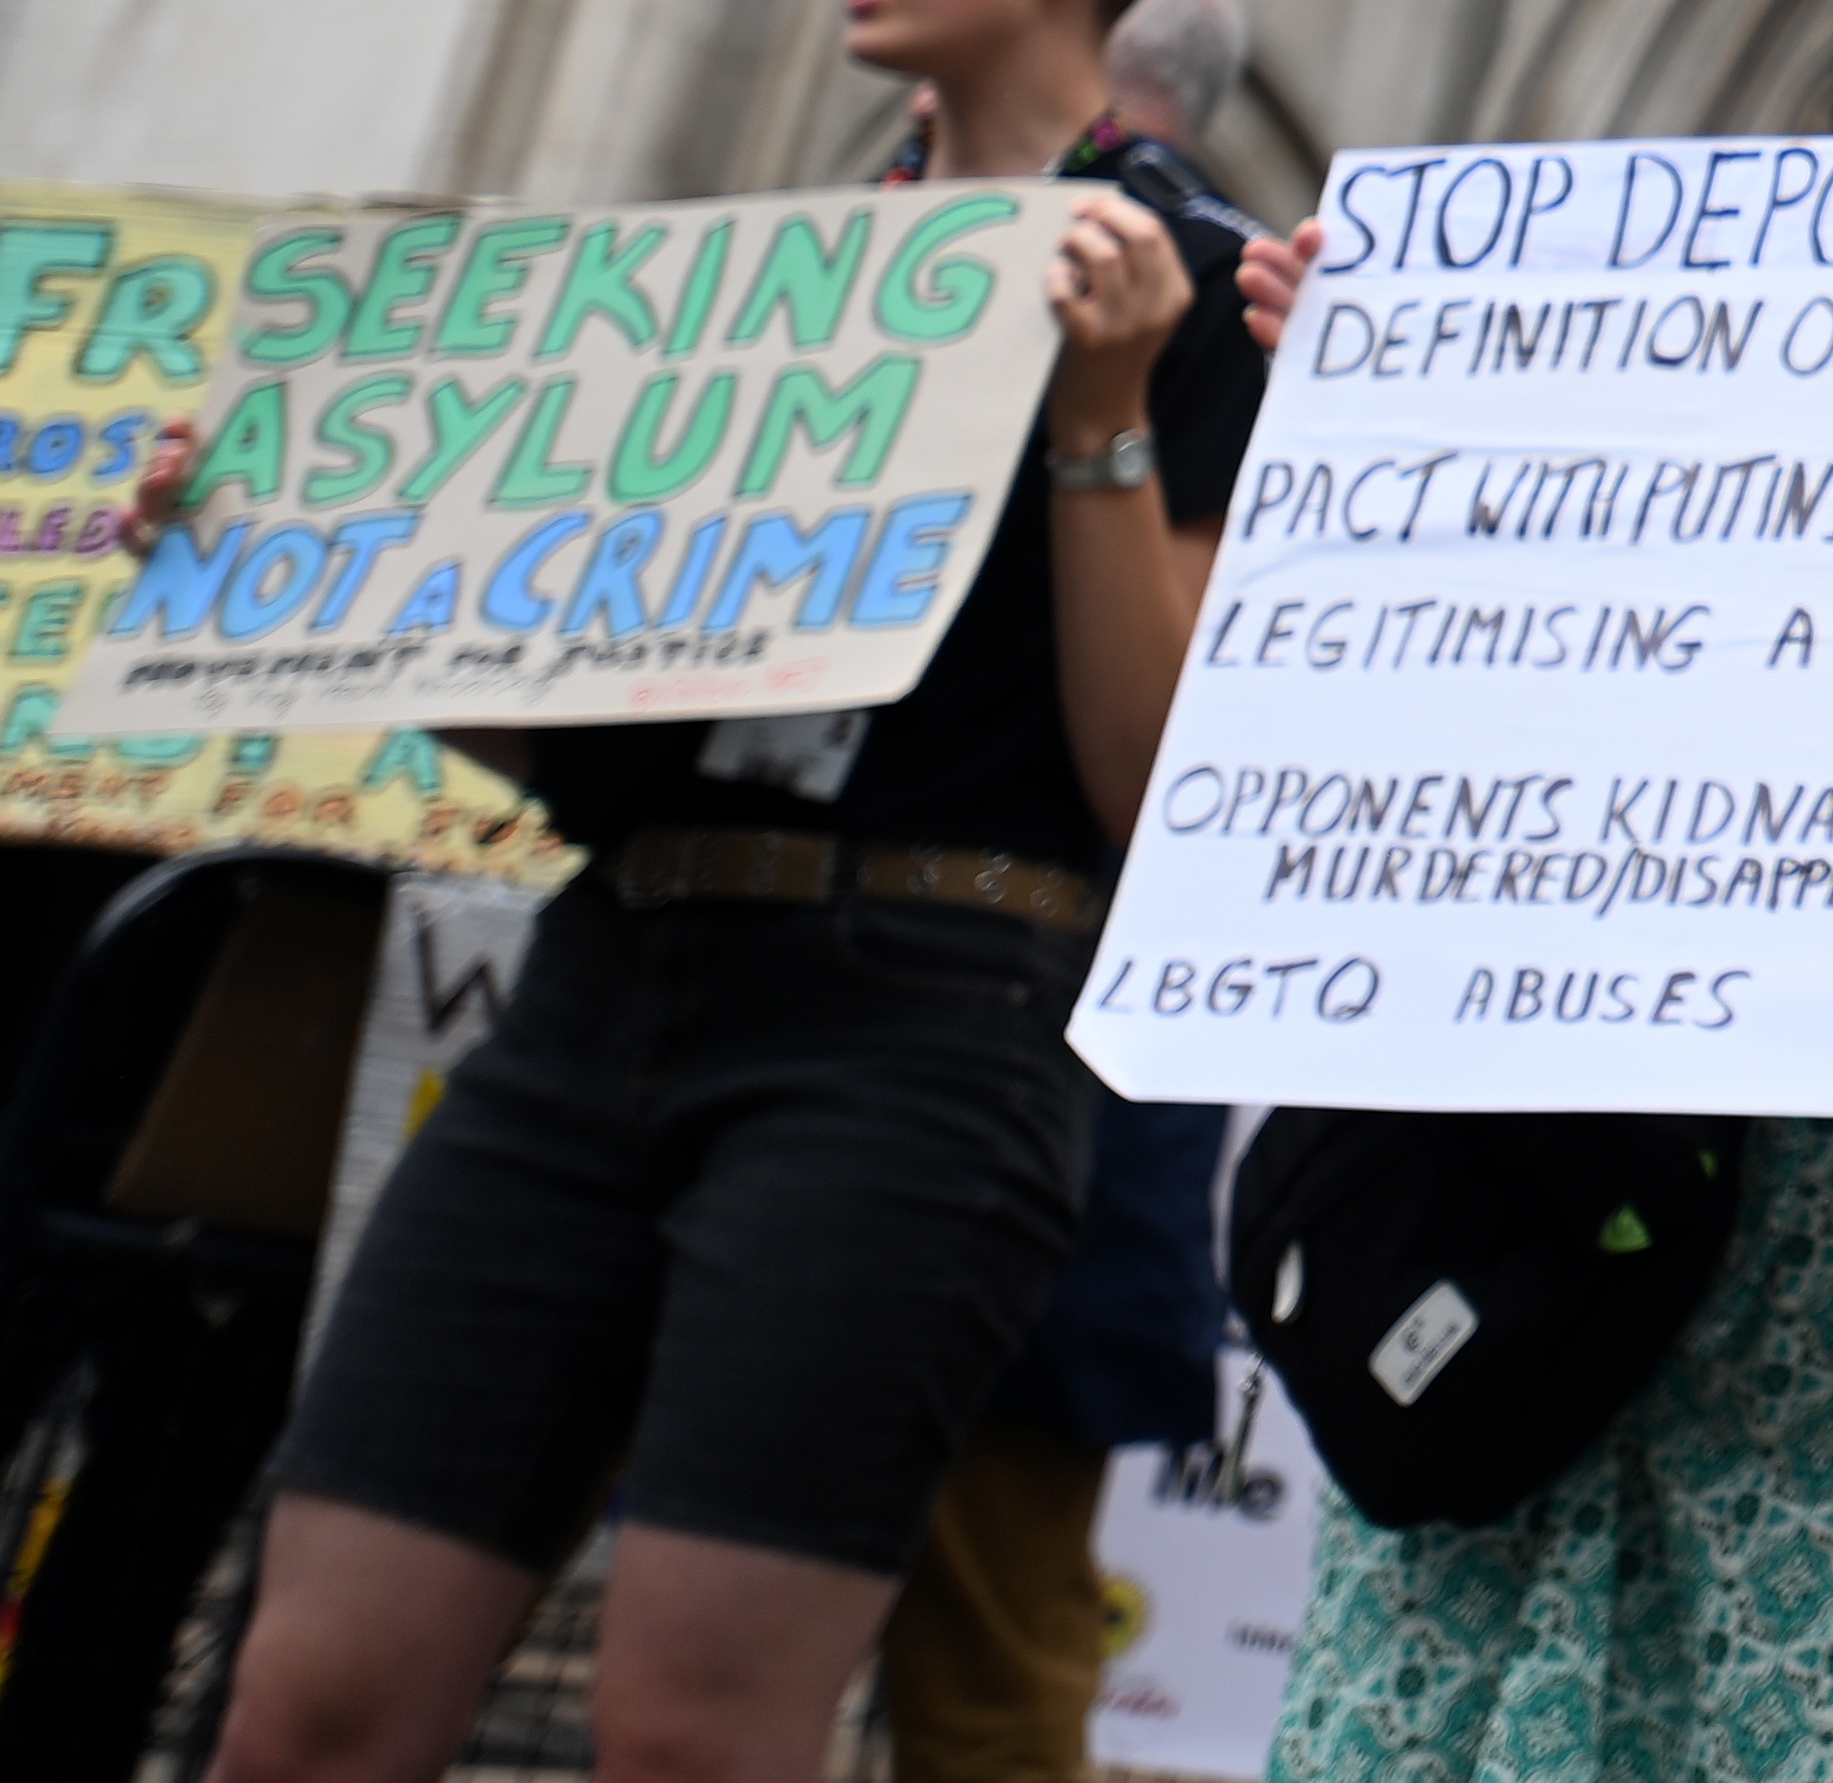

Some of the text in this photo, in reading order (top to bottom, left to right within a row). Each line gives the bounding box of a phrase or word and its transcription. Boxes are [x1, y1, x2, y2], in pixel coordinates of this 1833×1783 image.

[1319, 151, 1574, 275] STOP
[239, 193, 1020, 367] SEEKING
[1310, 294, 1778, 380] DEFINITION
[178, 352, 920, 509] ASYLUM
[1241, 451, 1459, 541] PACT
[1465, 452, 1630, 540] WITH
[107, 509, 421, 641] NOT
[477, 491, 976, 641] CRIME
[1205, 599, 1713, 673] LEGITIMISING
[1767, 602, 1816, 673] A
[1158, 764, 1576, 847] OPPONENTS
[1099, 954, 1753, 1030] LBGTQ ABUSES
